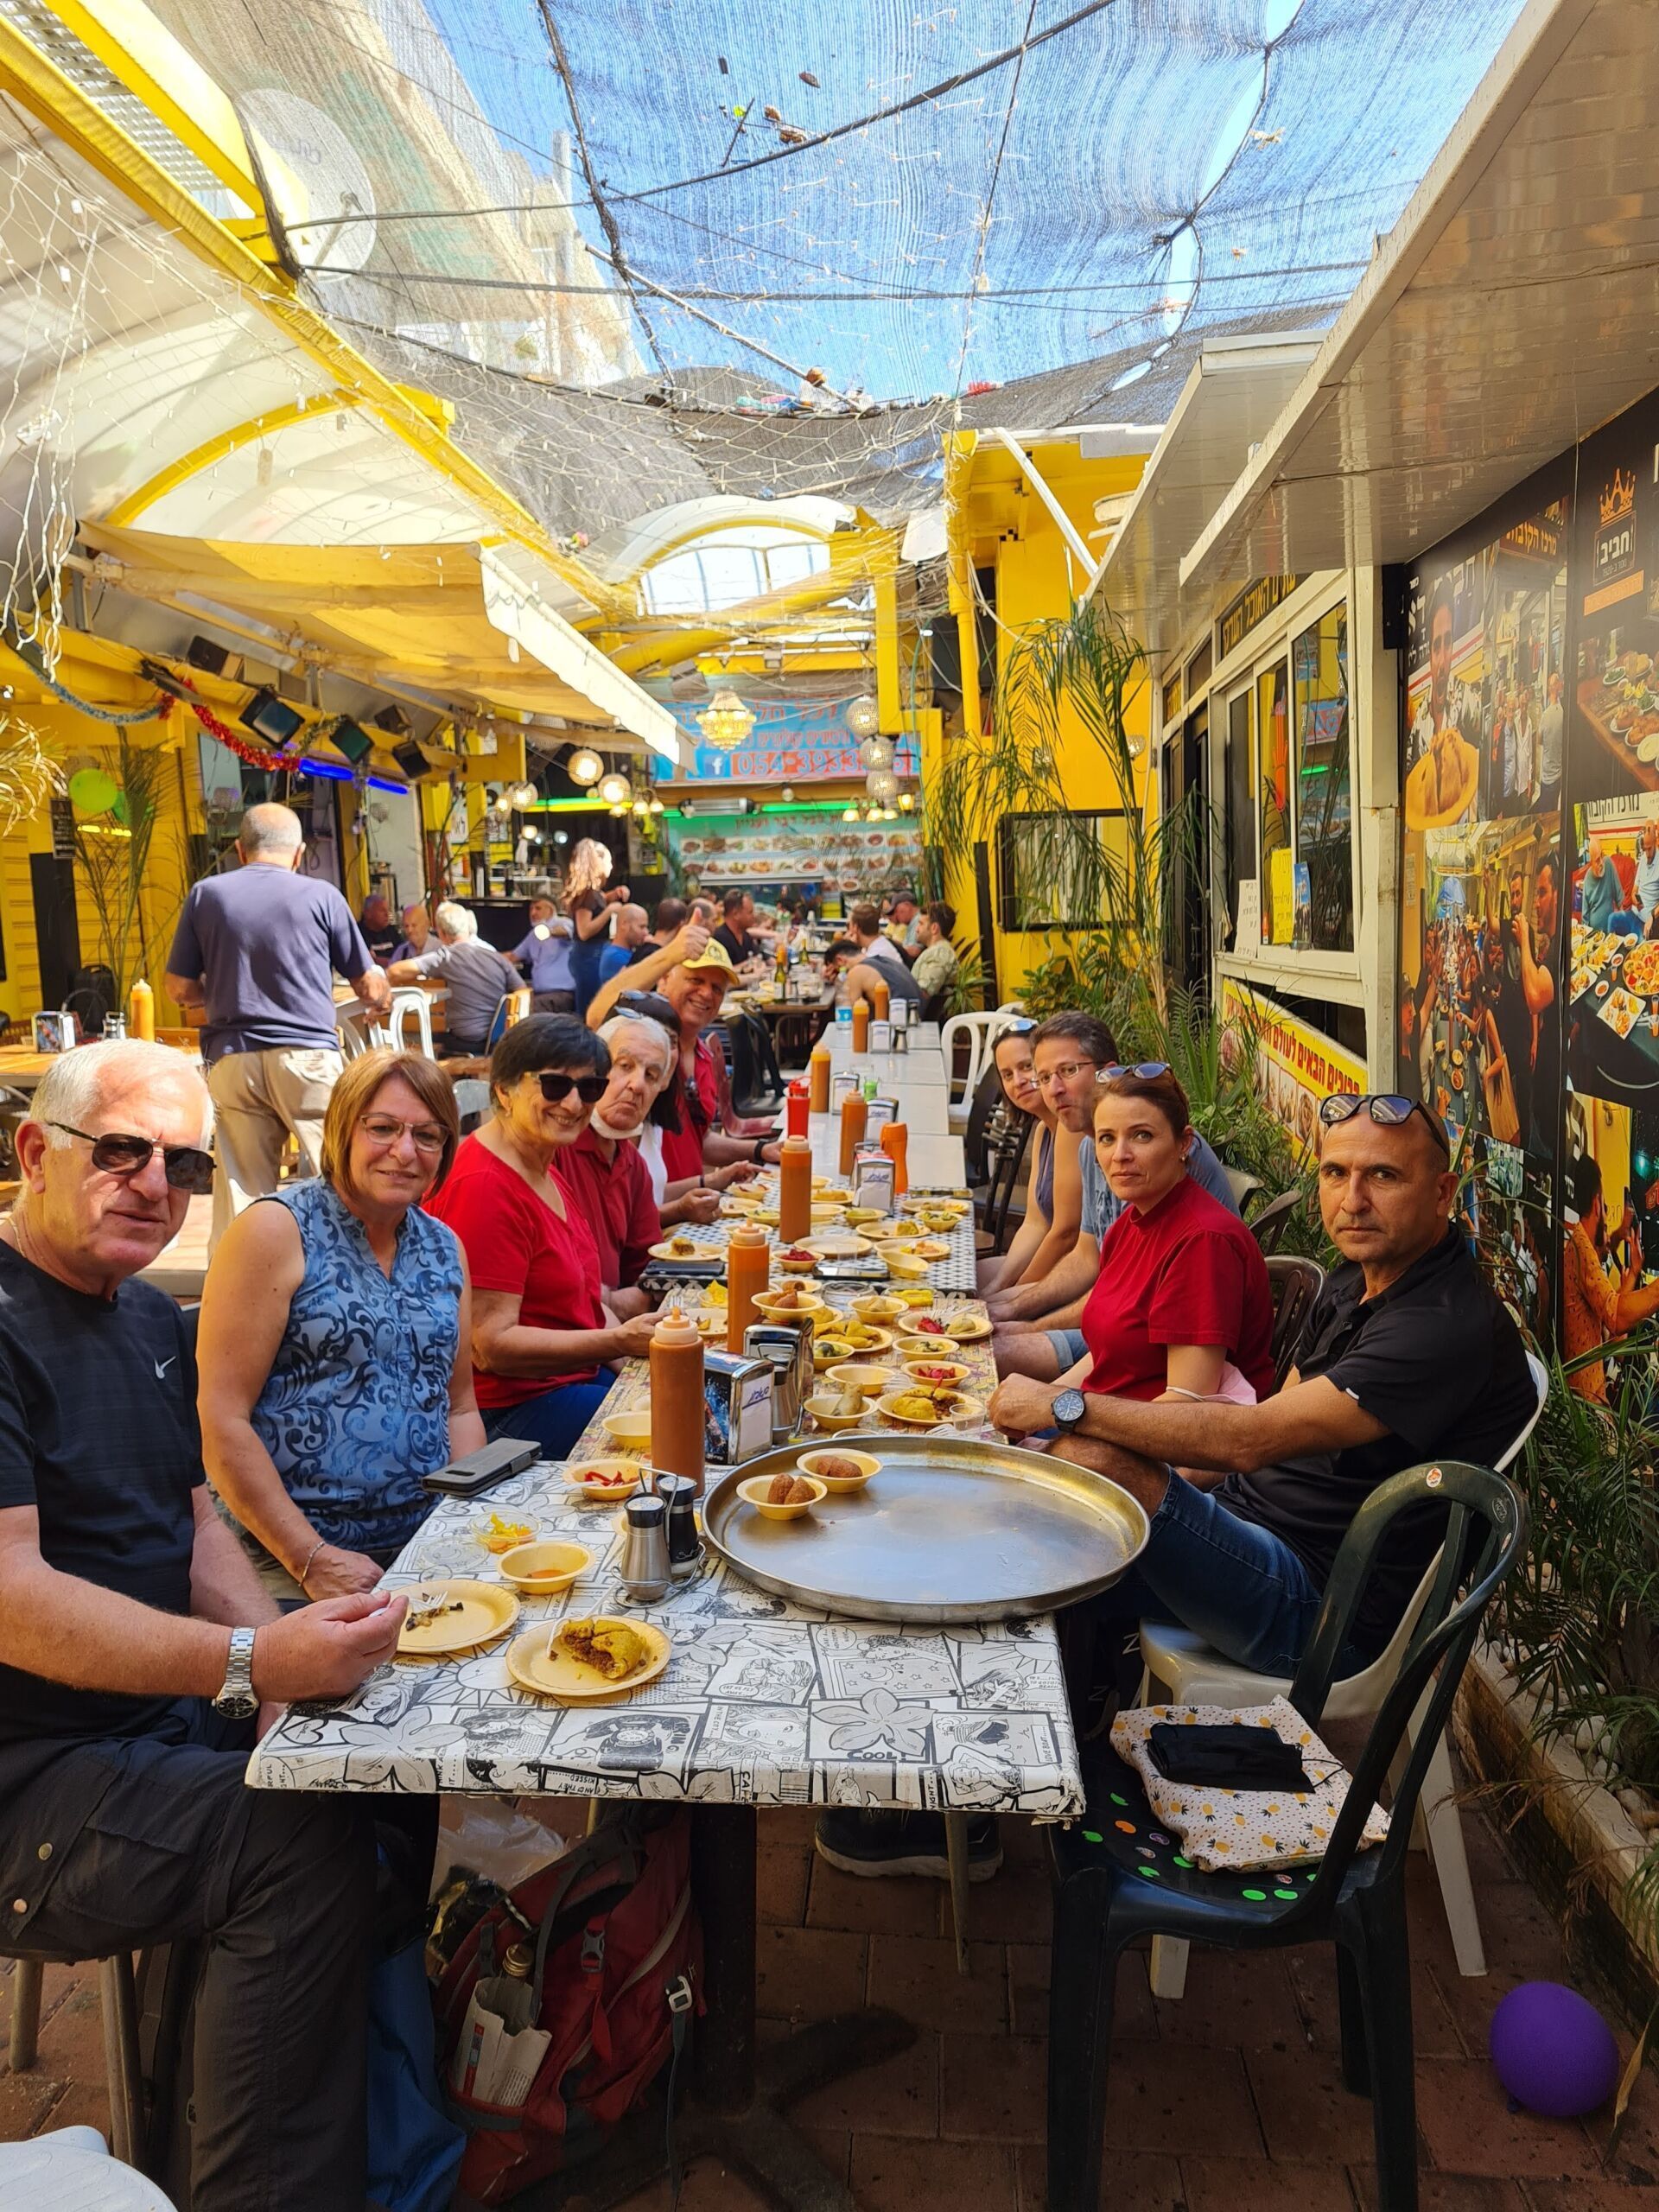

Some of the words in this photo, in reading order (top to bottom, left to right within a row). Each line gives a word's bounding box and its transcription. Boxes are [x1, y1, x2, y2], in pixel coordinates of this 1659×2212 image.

[1600, 531, 1630, 566] חביב
[1297, 1043, 1326, 1086] הבאים
[847, 1750, 907, 1761] COOL!
[577, 1786, 594, 1795] AND
